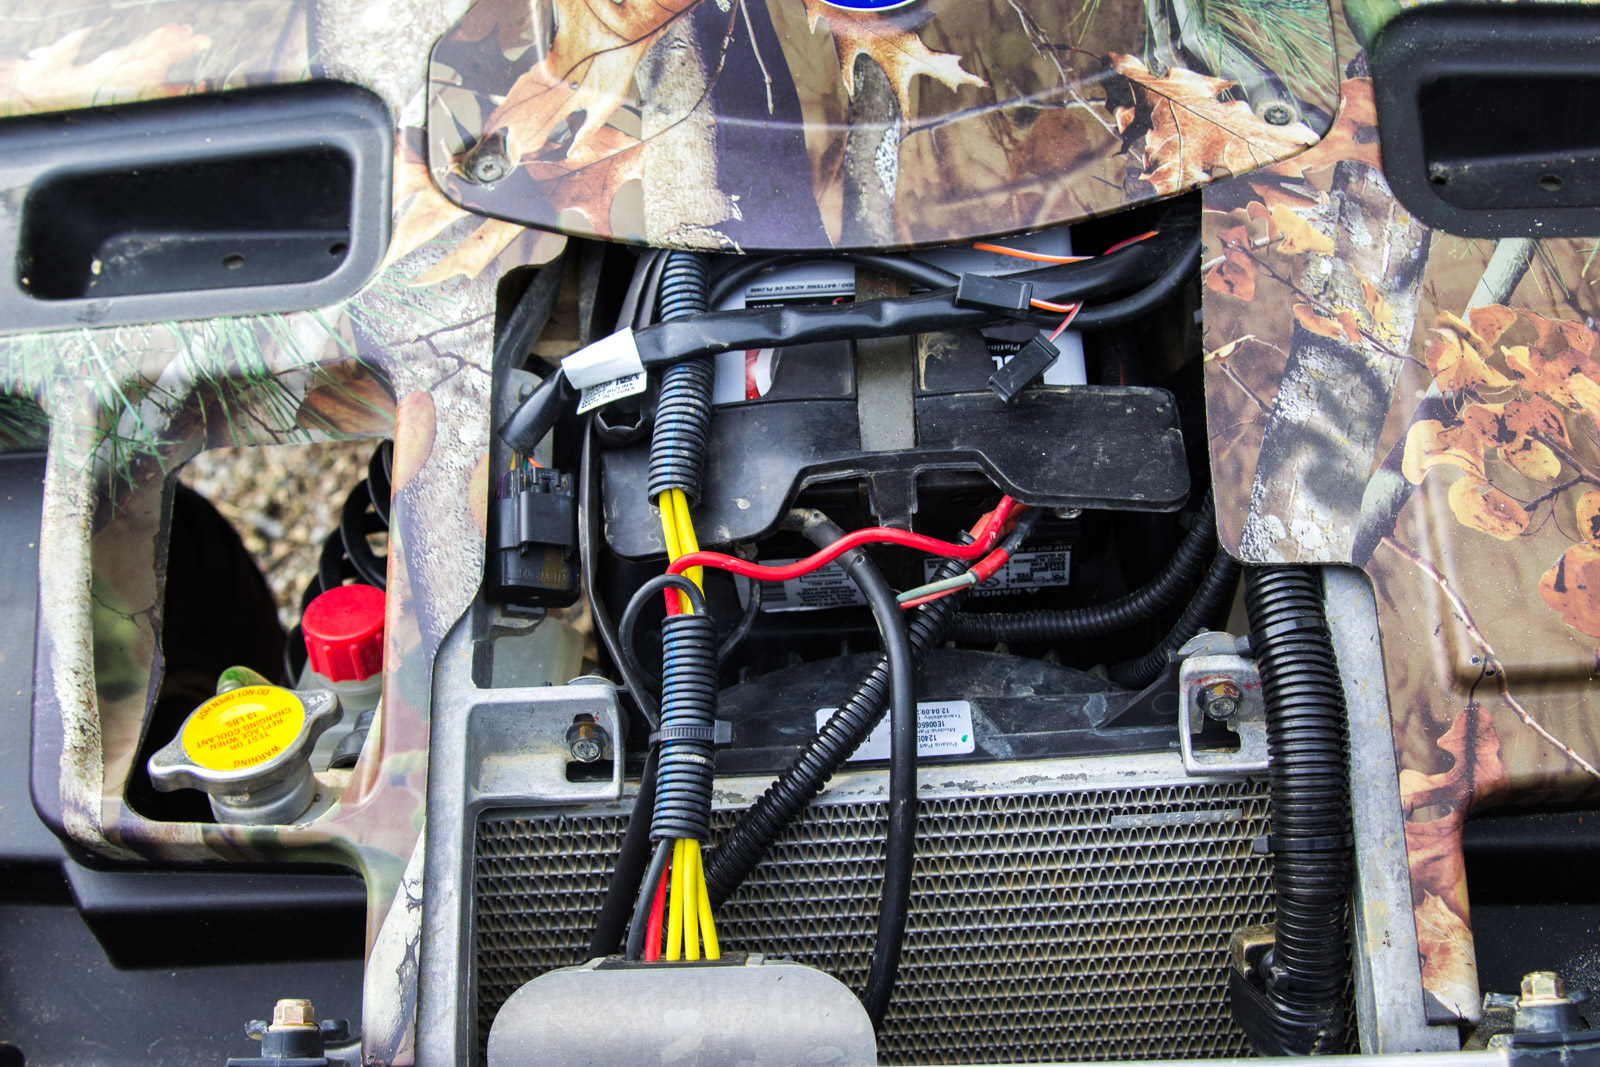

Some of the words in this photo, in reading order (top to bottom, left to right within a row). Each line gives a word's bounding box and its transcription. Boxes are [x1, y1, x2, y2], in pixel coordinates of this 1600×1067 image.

[238, 689, 255, 697] NOT
[257, 688, 270, 696] DO
[211, 694, 234, 708] OPEN
[196, 707, 213, 720] HOT
[242, 707, 292, 731] CHANGING
[247, 712, 257, 720] 13
[241, 718, 283, 739] REPLACE
[195, 728, 241, 748] COOLANT
[209, 737, 238, 750] WHEN
[247, 731, 269, 745] TEST
[229, 741, 243, 750] OR
[233, 745, 281, 768] WARNING
